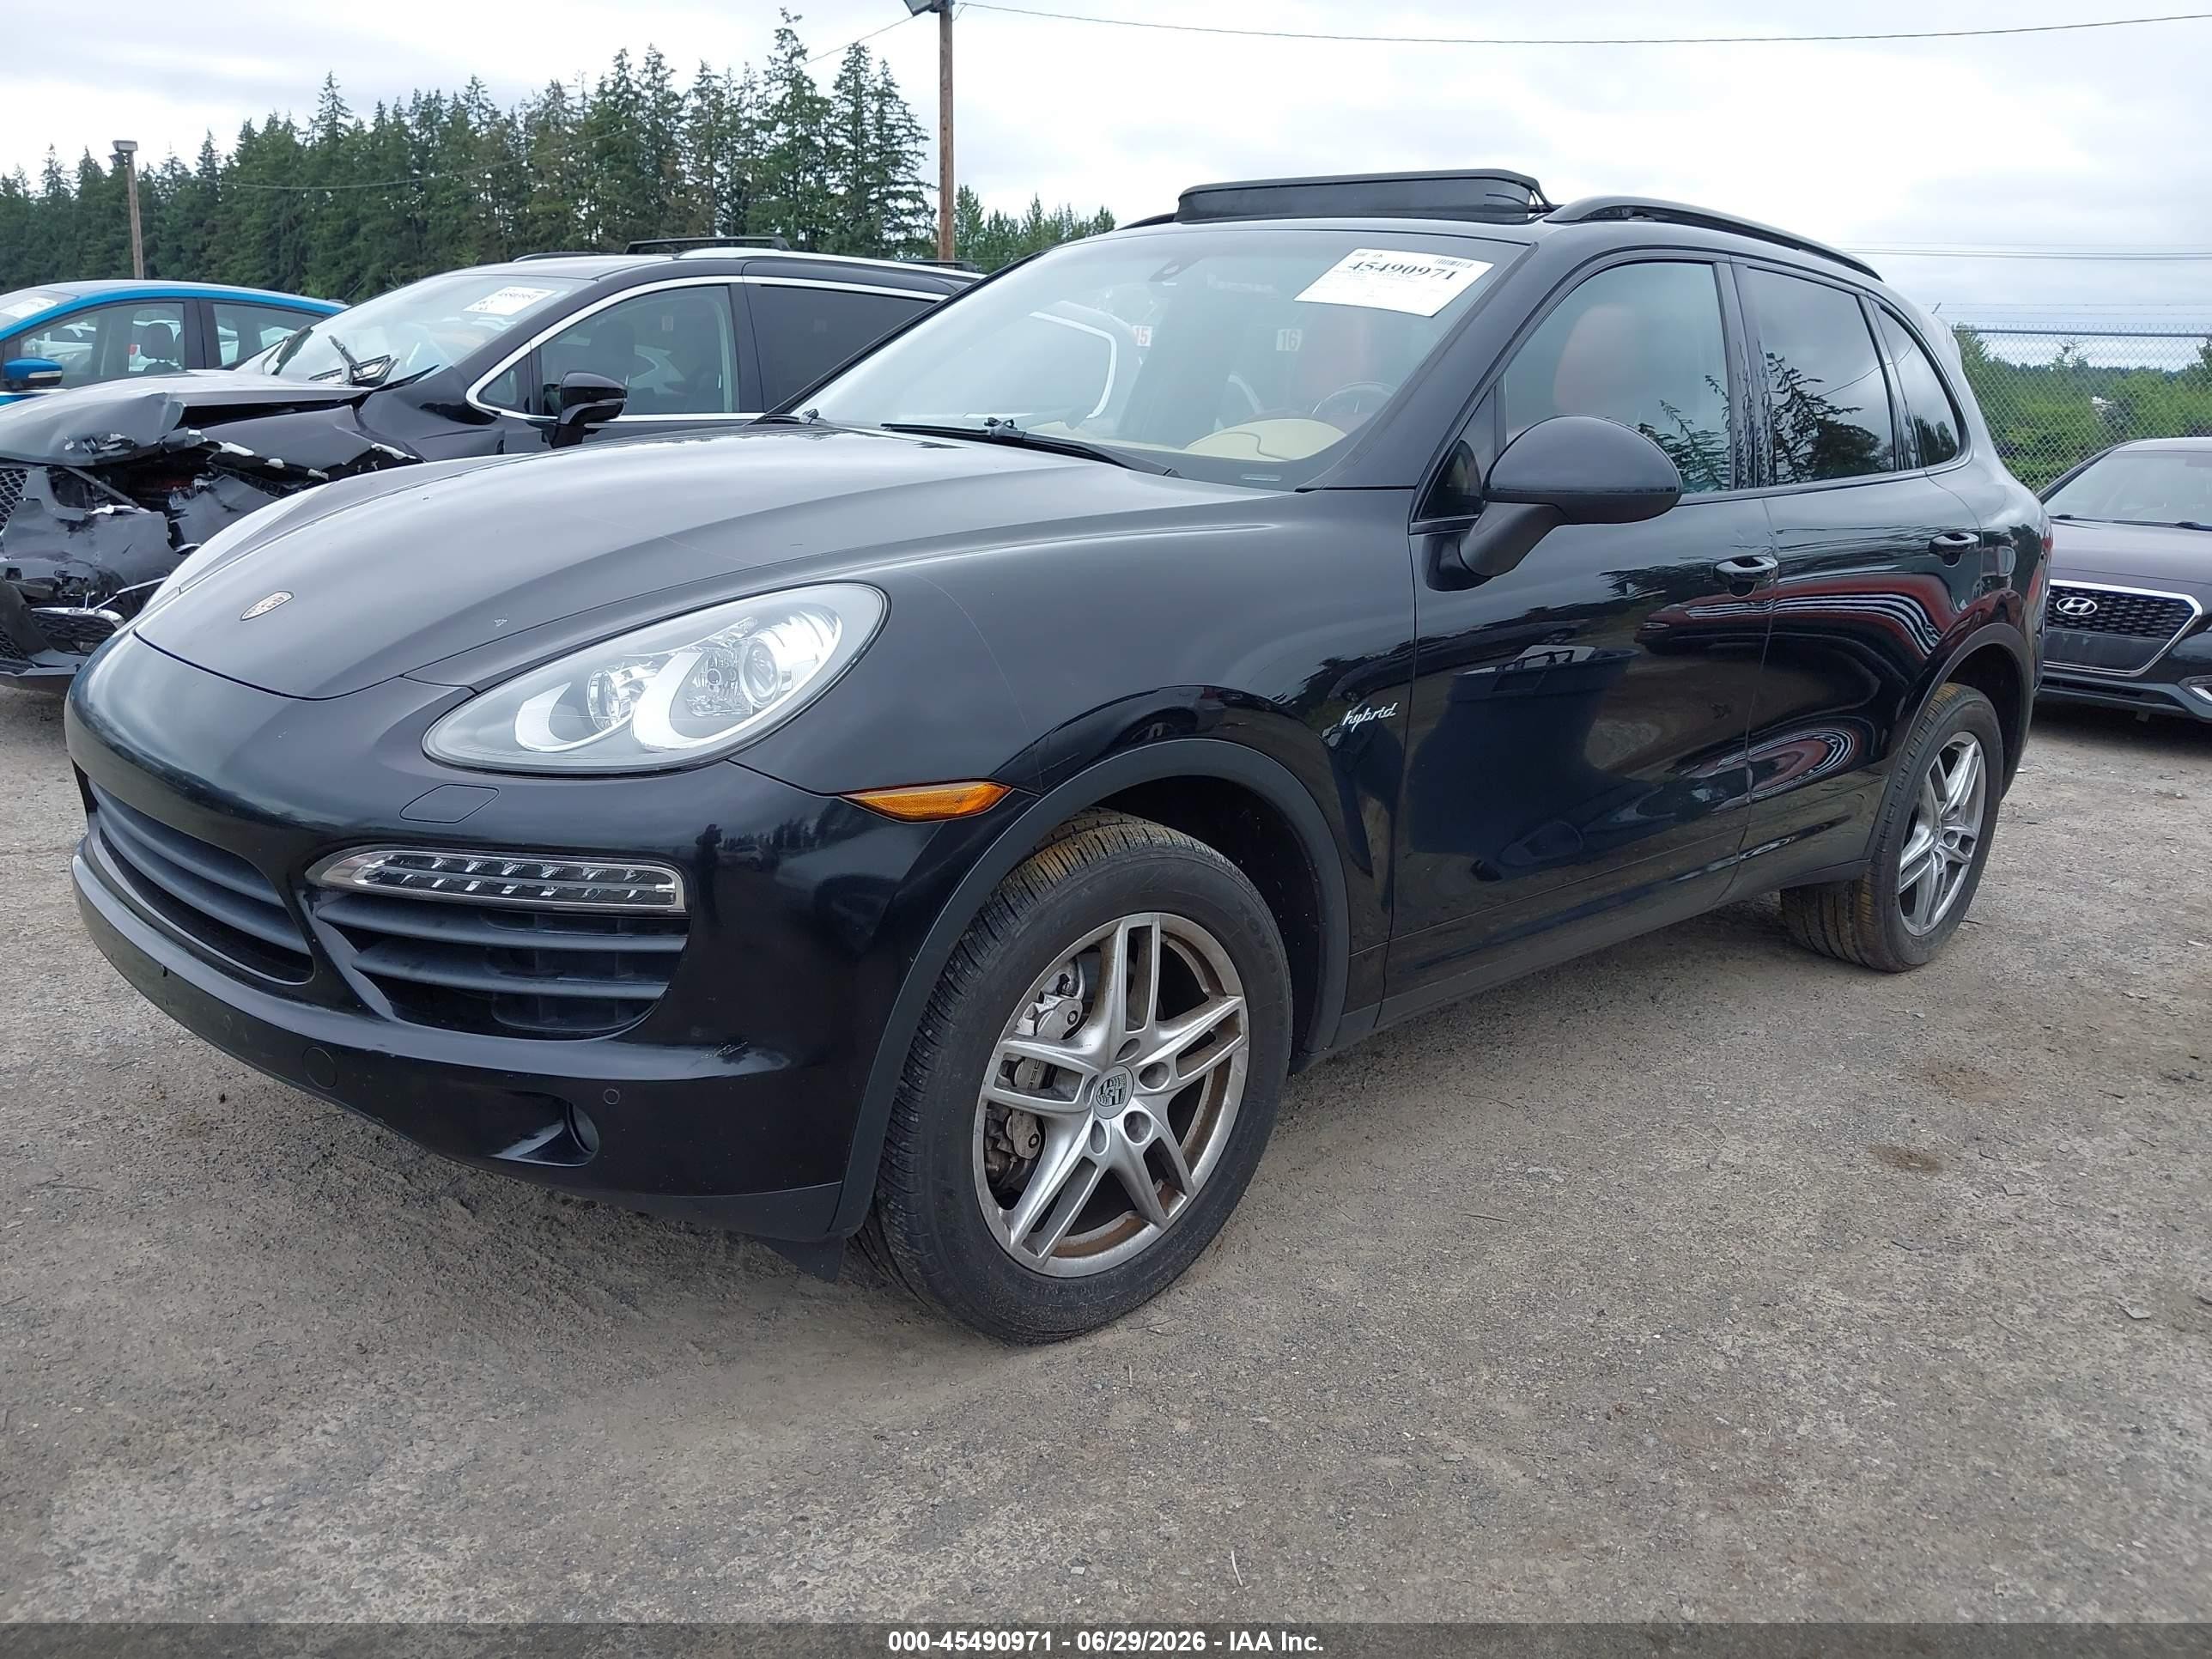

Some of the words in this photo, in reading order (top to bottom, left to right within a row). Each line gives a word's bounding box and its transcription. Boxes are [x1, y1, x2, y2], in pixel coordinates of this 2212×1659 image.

[1347, 260, 1458, 281] 45490971
[1280, 330, 1299, 350] 16
[1341, 702, 1399, 733] hybrid
